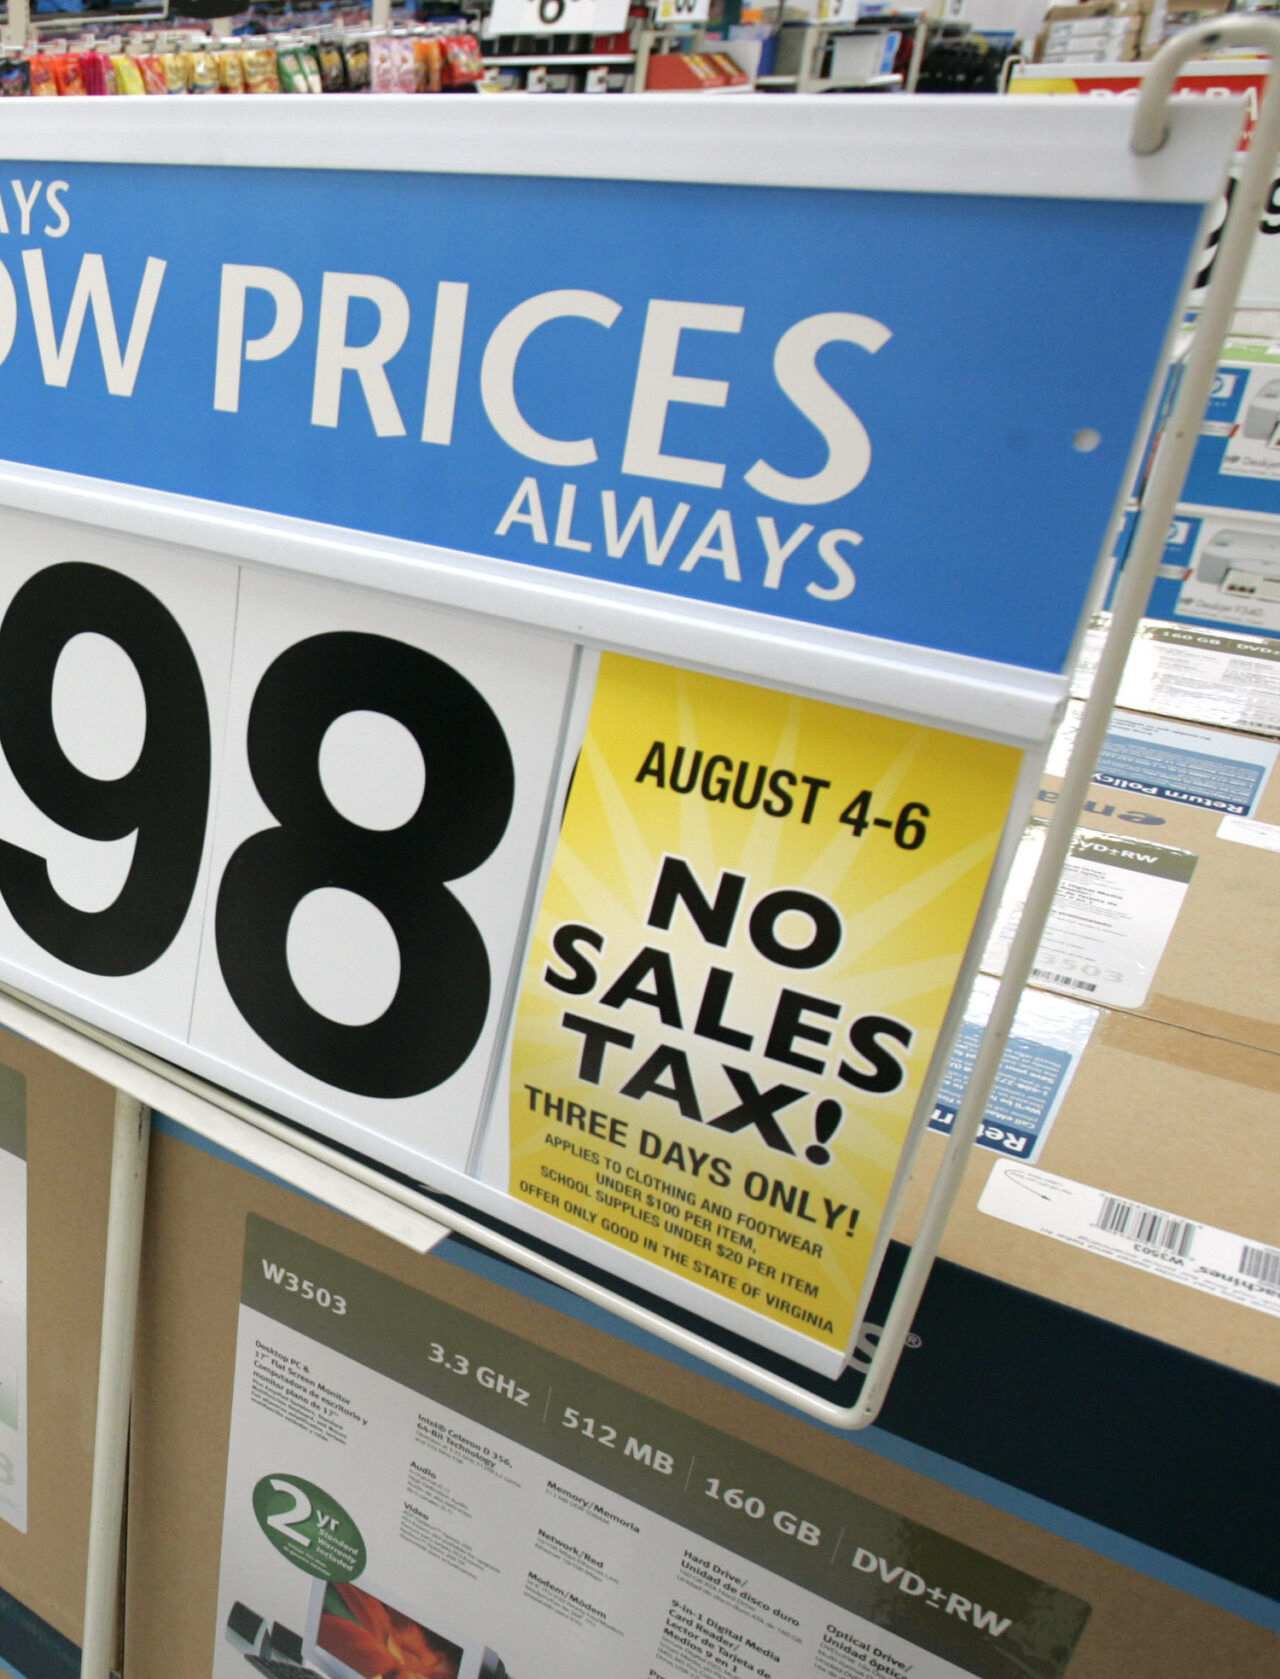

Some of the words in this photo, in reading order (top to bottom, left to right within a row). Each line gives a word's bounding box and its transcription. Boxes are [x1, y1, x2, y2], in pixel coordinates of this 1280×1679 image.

[213, 261, 894, 506] PRICES
[494, 475, 864, 601] ALWAYS
[1162, 630, 1194, 642] 160
[1196, 636, 1222, 647] GB
[635, 740, 831, 826] AUGUST
[839, 789, 932, 851] 4-6
[1164, 789, 1245, 815] Return
[648, 855, 842, 970] NO
[545, 922, 915, 1094] SALES
[561, 1012, 843, 1166] TAX!
[524, 1084, 630, 1147] THREE
[639, 1129, 733, 1188] DAYS
[743, 1170, 861, 1239] ONLY!
[544, 1132, 601, 1166] APPLIES
[604, 1156, 623, 1175] TO
[625, 1162, 698, 1207] CLOTHING
[700, 1198, 733, 1221] AND
[736, 1213, 825, 1260] FOOTWEAR
[595, 1171, 643, 1201] UNDER
[645, 1189, 682, 1219] $100
[684, 1205, 715, 1231] PER
[716, 1223, 757, 1255] ITEM,
[519, 1179, 562, 1211] OFFER
[563, 1198, 598, 1226] ONLY
[600, 1216, 641, 1245] GOOD
[643, 1233, 658, 1253] IN
[661, 1244, 692, 1268] THE
[692, 1259, 739, 1292] STATE
[740, 1279, 763, 1300] OF
[765, 1291, 836, 1336] VIRGINIA
[540, 1164, 593, 1199] SCHOOL
[595, 1186, 662, 1229] SUPPLIES
[663, 1218, 713, 1253] UNDER
[716, 1242, 744, 1267] $20
[747, 1255, 779, 1283] PER
[780, 1273, 819, 1300] ITEM
[1132, 1243, 1185, 1267] W3503
[261, 1257, 348, 1317] W3503
[255, 1340, 288, 1363] Desktop
[290, 1358, 301, 1369] PC
[271, 1358, 286, 1372] Flat
[287, 1367, 316, 1388] Screen
[317, 1383, 350, 1406] Monitor
[427, 1341, 470, 1377] 3.3
[475, 1364, 532, 1407] GHz
[253, 1370, 283, 1391] monitor
[286, 1387, 308, 1405] plano
[310, 1400, 320, 1410] de
[253, 1359, 307, 1394] Computadora
[308, 1389, 319, 1400] de
[320, 1395, 360, 1422] escritorio
[362, 1418, 367, 1426] y
[410, 1459, 436, 1480] Audio
[446, 1436, 495, 1469] Technology
[447, 1428, 481, 1452] Celeron
[483, 1446, 489, 1456] D
[561, 1406, 617, 1450] 512
[623, 1434, 676, 1476] MB
[266, 1477, 314, 1549] 2
[315, 1508, 341, 1533] yr
[403, 1501, 429, 1521] Video
[546, 1479, 640, 1535] Memory/Memoria
[705, 1476, 767, 1521] 160
[772, 1508, 822, 1549] GB
[537, 1527, 604, 1570] Network/Red
[683, 1548, 710, 1570] Hard
[712, 1563, 747, 1589] Drive/
[681, 1558, 721, 1586] Unidad
[722, 1580, 736, 1594] de
[739, 1589, 770, 1612] disco
[772, 1606, 799, 1627] duro
[850, 1546, 1014, 1638] DVD±RW
[663, 1626, 702, 1654] Medios
[704, 1649, 713, 1660] 9
[714, 1655, 728, 1669] en
[731, 1663, 737, 1673] 1
[665, 1617, 698, 1641] Lector
[700, 1636, 714, 1650] de
[717, 1645, 754, 1672] Tarjeta
[668, 1608, 693, 1628] Card
[695, 1622, 739, 1653] Reader/
[671, 1598, 702, 1622] 9-in-1
[705, 1617, 742, 1644] Digital
[744, 1638, 780, 1664] Media
[822, 1631, 867, 1663] Unidad
[825, 1621, 871, 1655] Optical
[872, 1646, 913, 1675] Drive/
